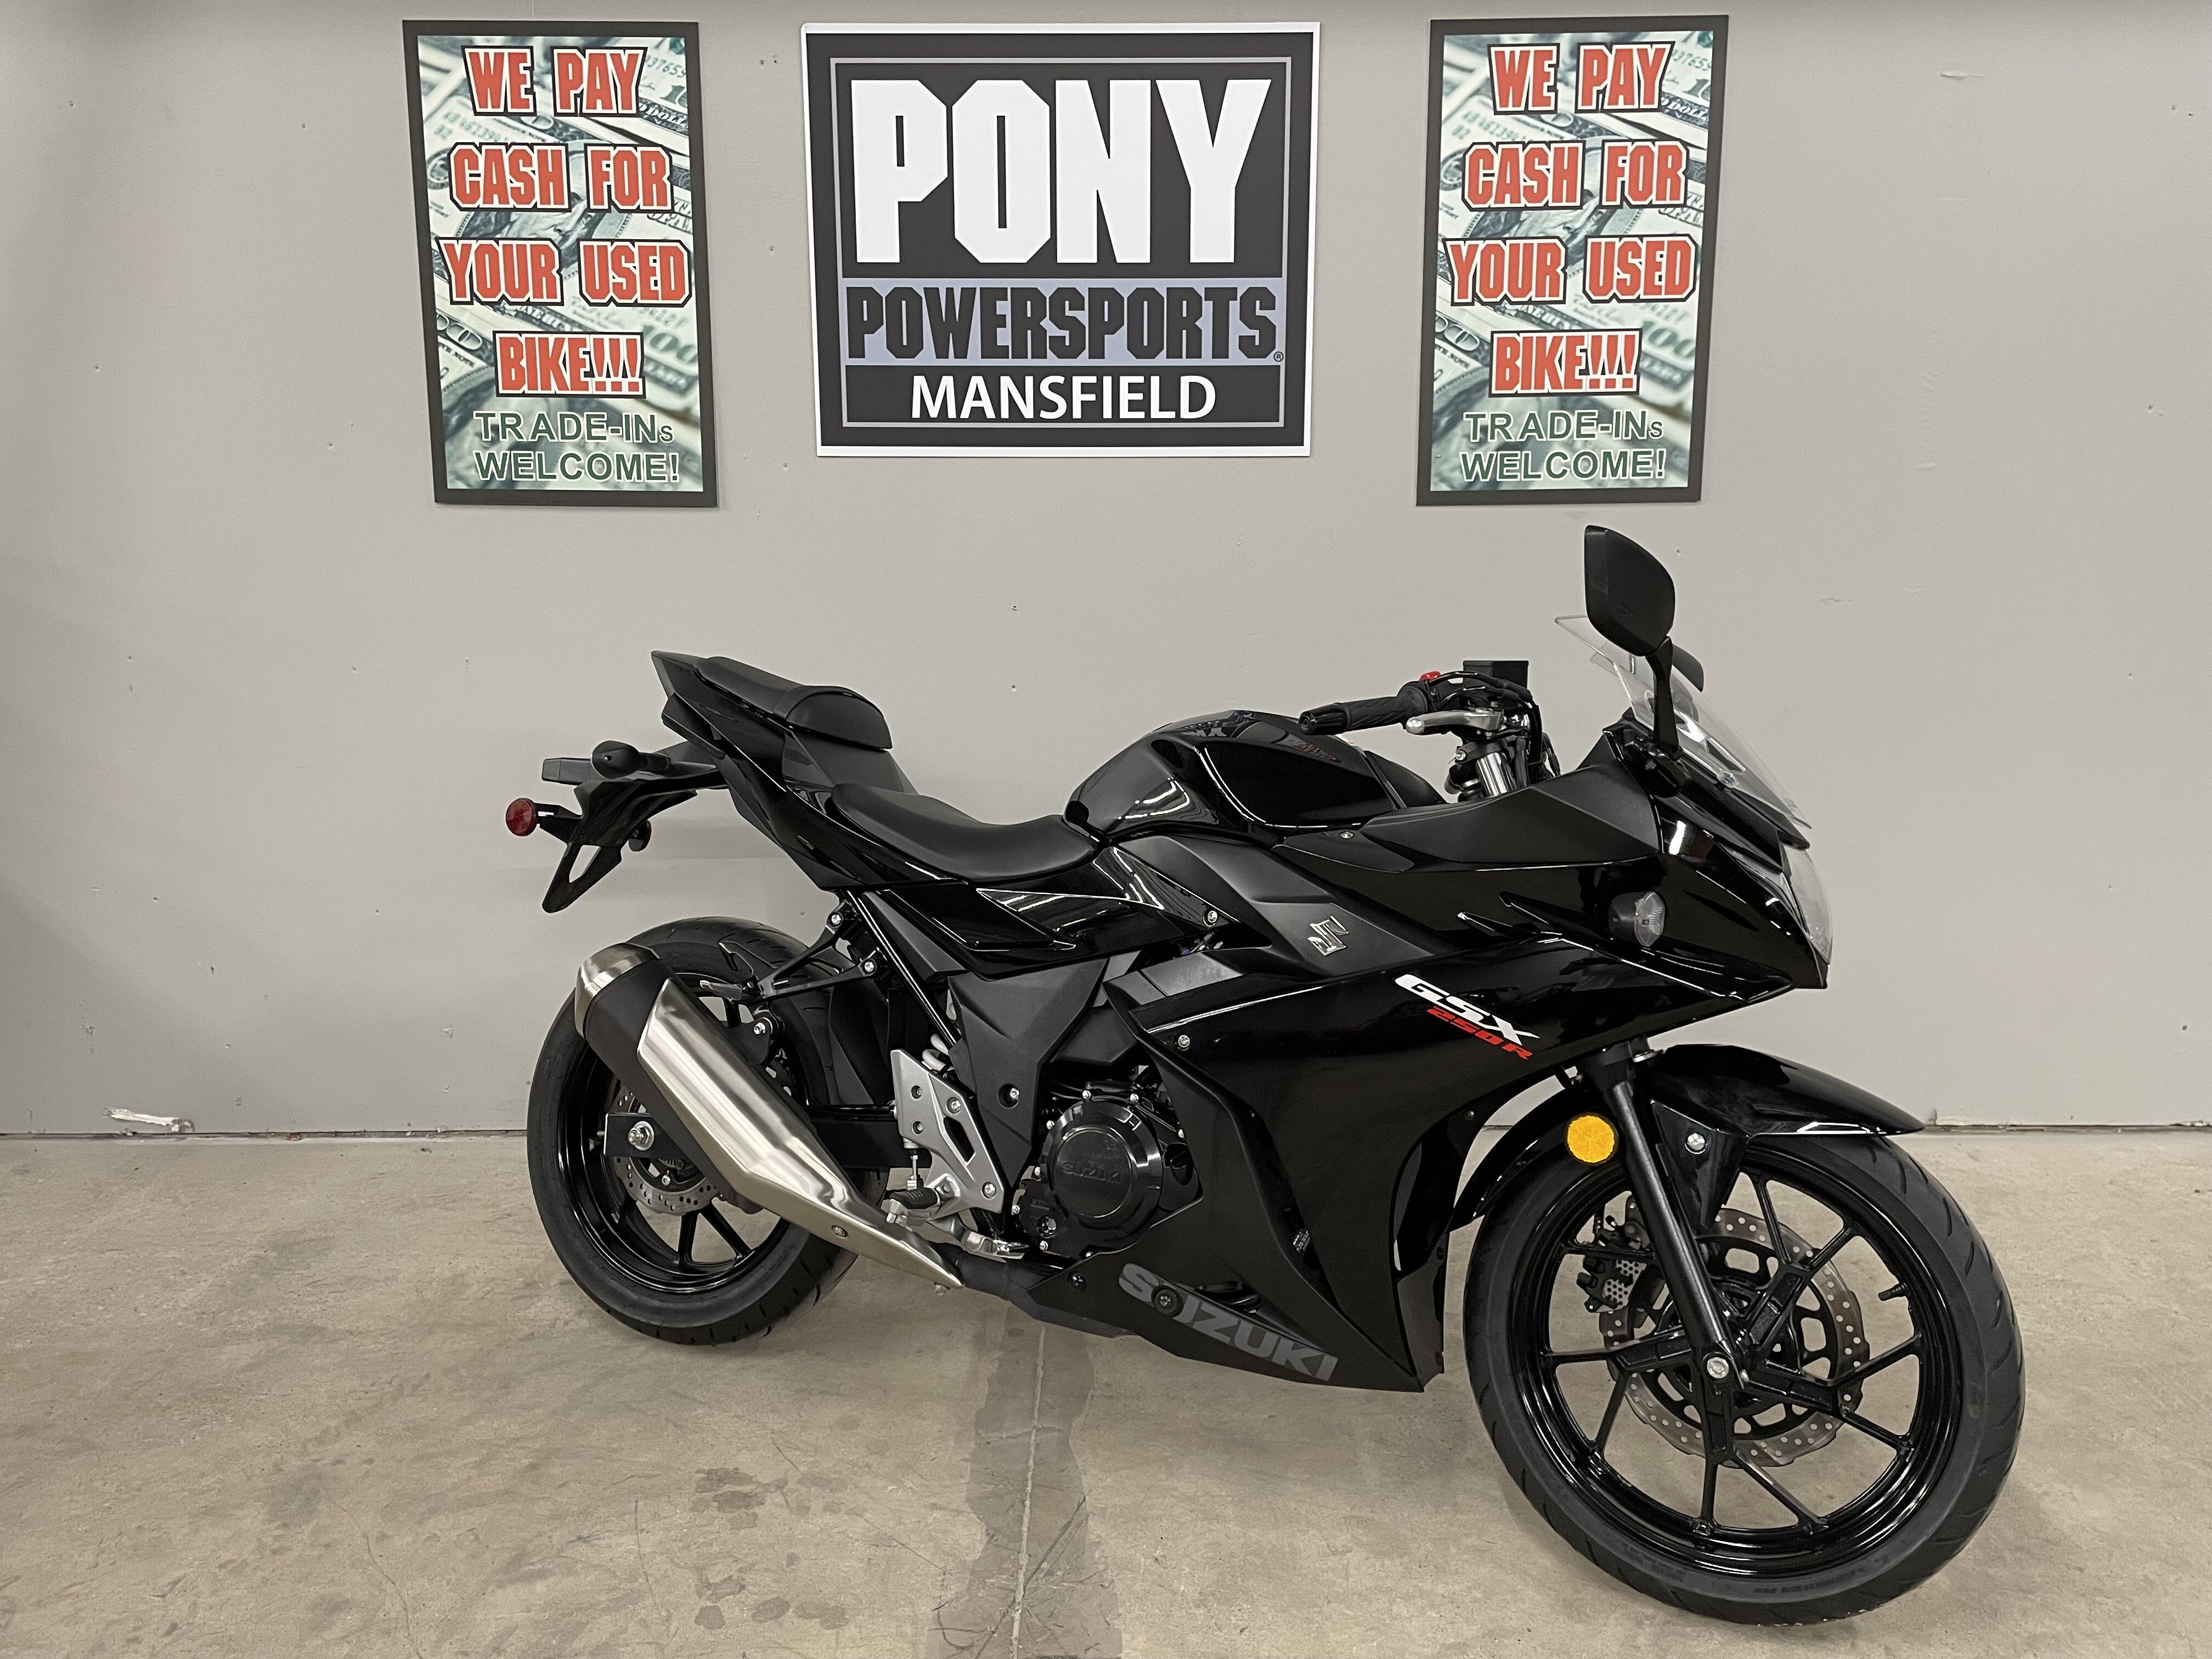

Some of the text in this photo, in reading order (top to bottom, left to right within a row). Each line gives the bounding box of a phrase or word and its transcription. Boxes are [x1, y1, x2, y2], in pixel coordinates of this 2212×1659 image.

[464, 47, 644, 114] WE PAY
[1490, 43, 1672, 112] WE PAY
[450, 144, 672, 210] CASH FOR
[851, 79, 1272, 263] PONY
[1464, 140, 1687, 208] CASH FOR
[439, 239, 690, 304] YOUR USED
[1446, 236, 1696, 303] YOUR USED
[495, 332, 643, 395] BIKE!!!
[1492, 330, 1640, 394] BIKE!!!
[911, 375, 1216, 419] MANSFIELD
[473, 450, 680, 484] WELCOME!
[1460, 449, 1666, 482] WELCOME!
[1395, 974, 1541, 1046] GSX
[1426, 1006, 1533, 1060] 250R
